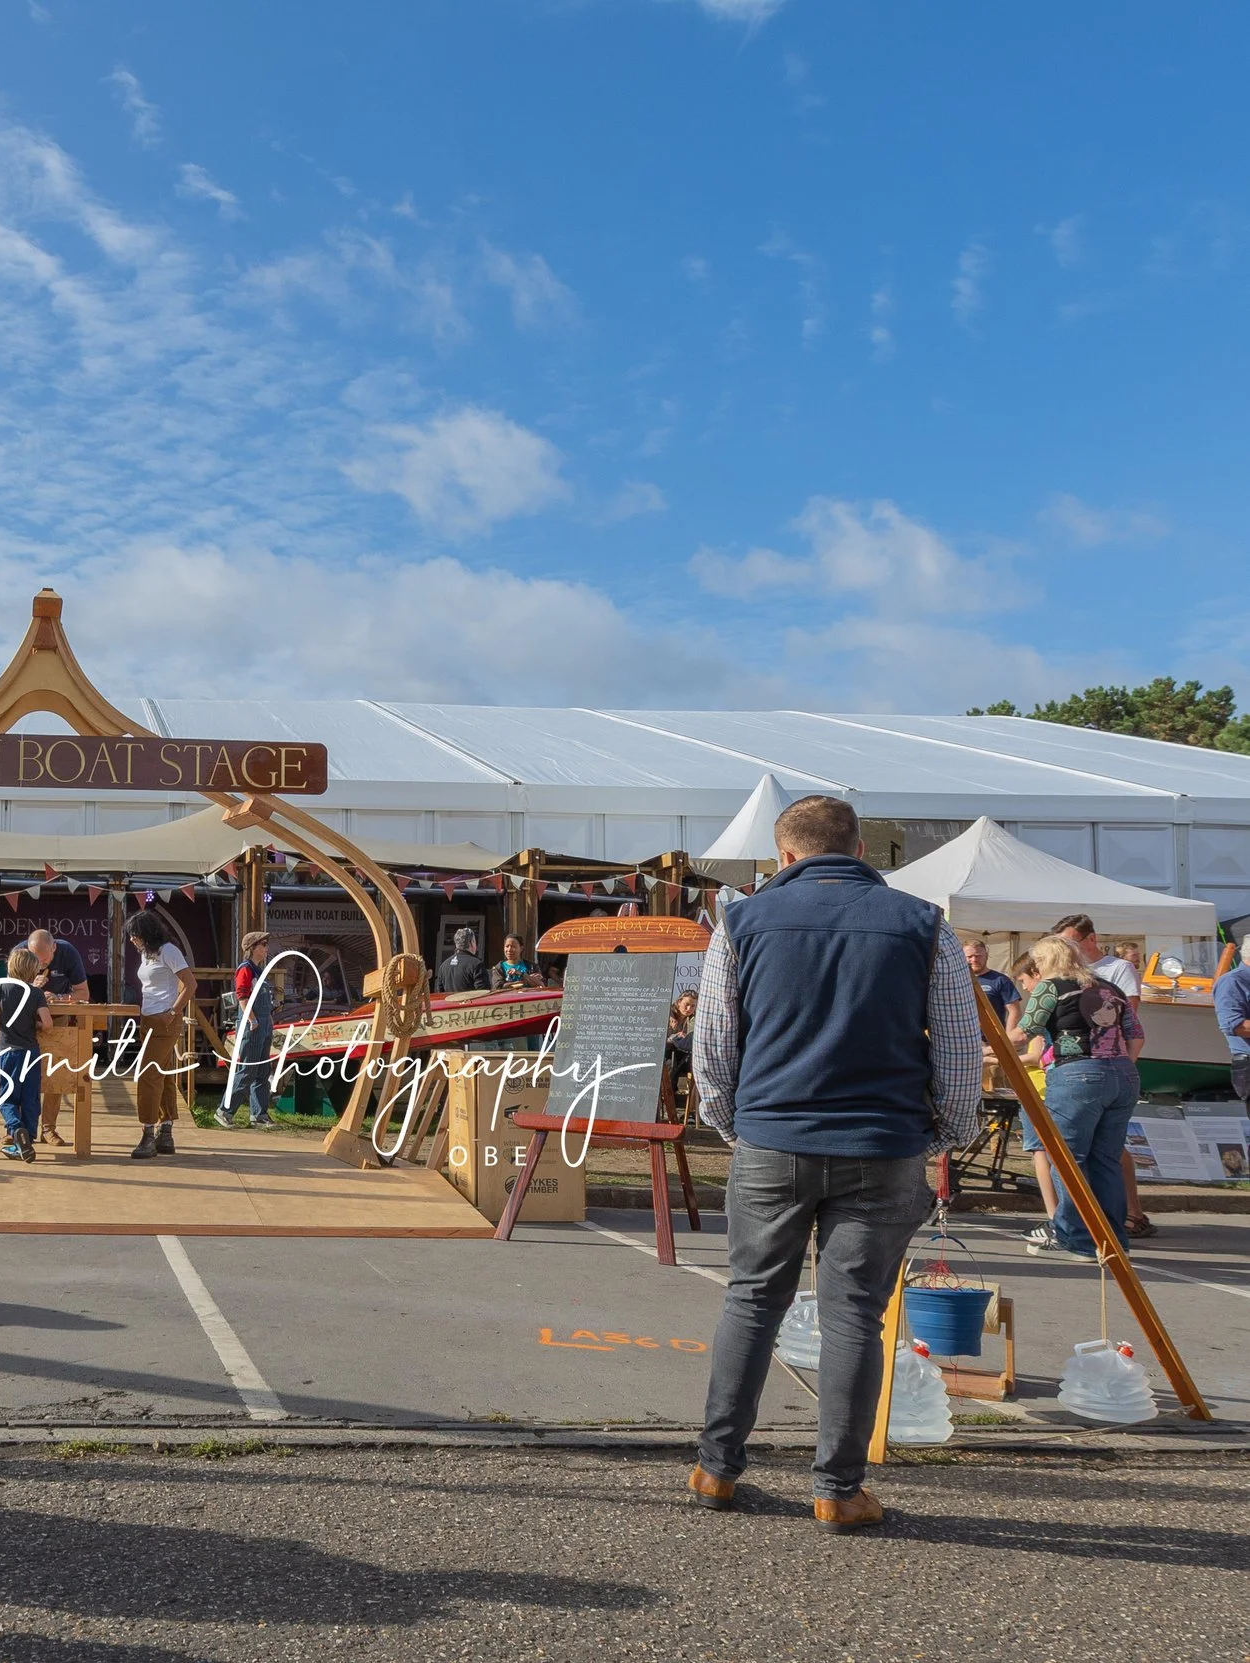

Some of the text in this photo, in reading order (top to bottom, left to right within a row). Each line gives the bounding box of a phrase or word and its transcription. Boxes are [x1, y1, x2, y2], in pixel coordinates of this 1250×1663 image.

[17, 738, 145, 785] BOAT
[159, 743, 308, 790] STAGE
[266, 908, 302, 920] WOMEN
[303, 909, 313, 920] IN
[315, 910, 339, 921] BOAT
[47, 918, 98, 936] BOAT
[550, 921, 609, 943] WOODEN
[615, 920, 651, 931] BOAT
